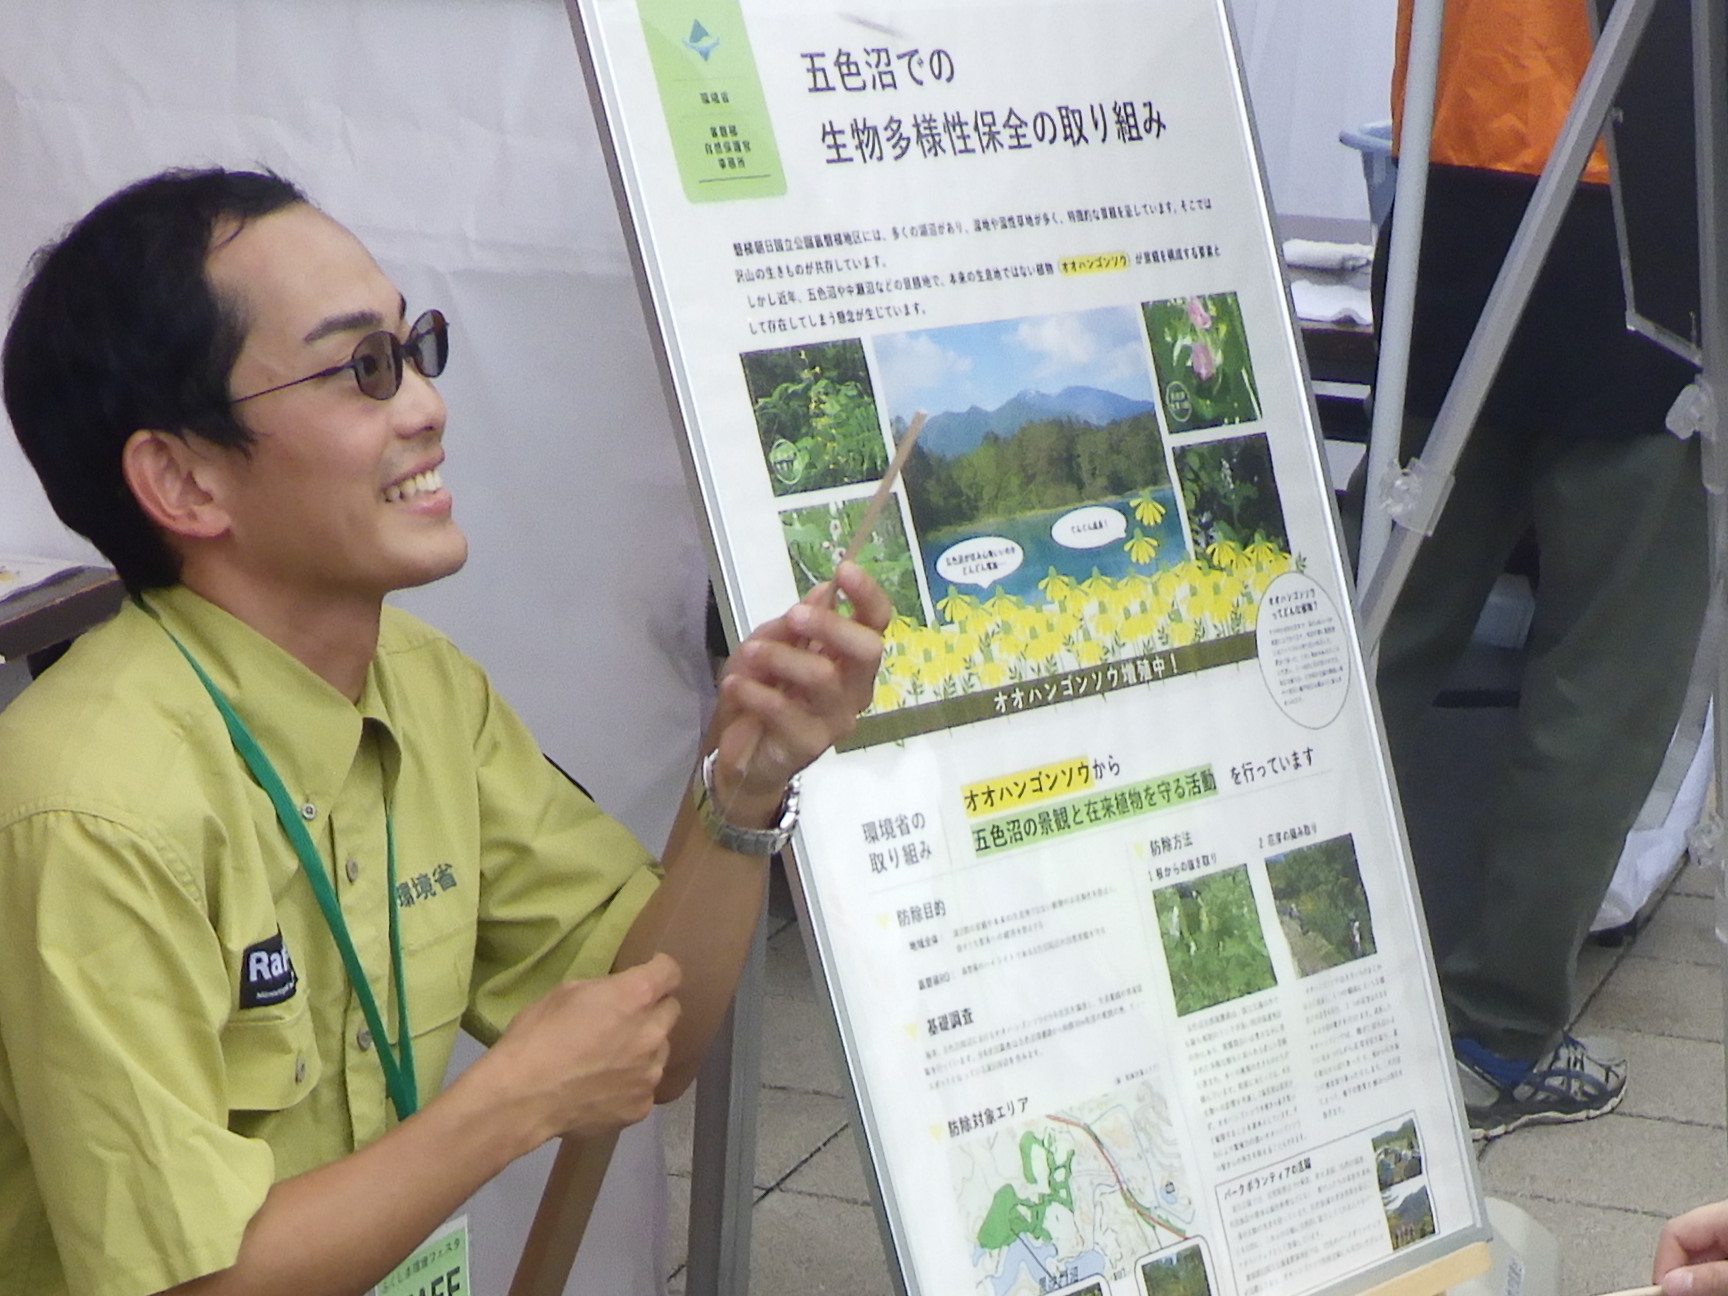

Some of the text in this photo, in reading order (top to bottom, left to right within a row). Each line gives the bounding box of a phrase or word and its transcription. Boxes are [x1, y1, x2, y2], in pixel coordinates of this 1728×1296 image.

[800, 47, 955, 93] 五色沼での
[821, 100, 1166, 165] 生物多様性保全の取り組み
[964, 755, 1121, 812] オオハンゴンソウから
[972, 747, 1314, 853] 五色沼の景観と在来植物を守る活動 を行っています
[861, 812, 926, 844] 環境省の
[1149, 831, 1194, 857] 防除方法
[869, 840, 932, 874] 取り組み
[396, 863, 457, 907] 環境省
[896, 899, 947, 928] 防除目的
[947, 1096, 1029, 1138] 防除対象エリア
